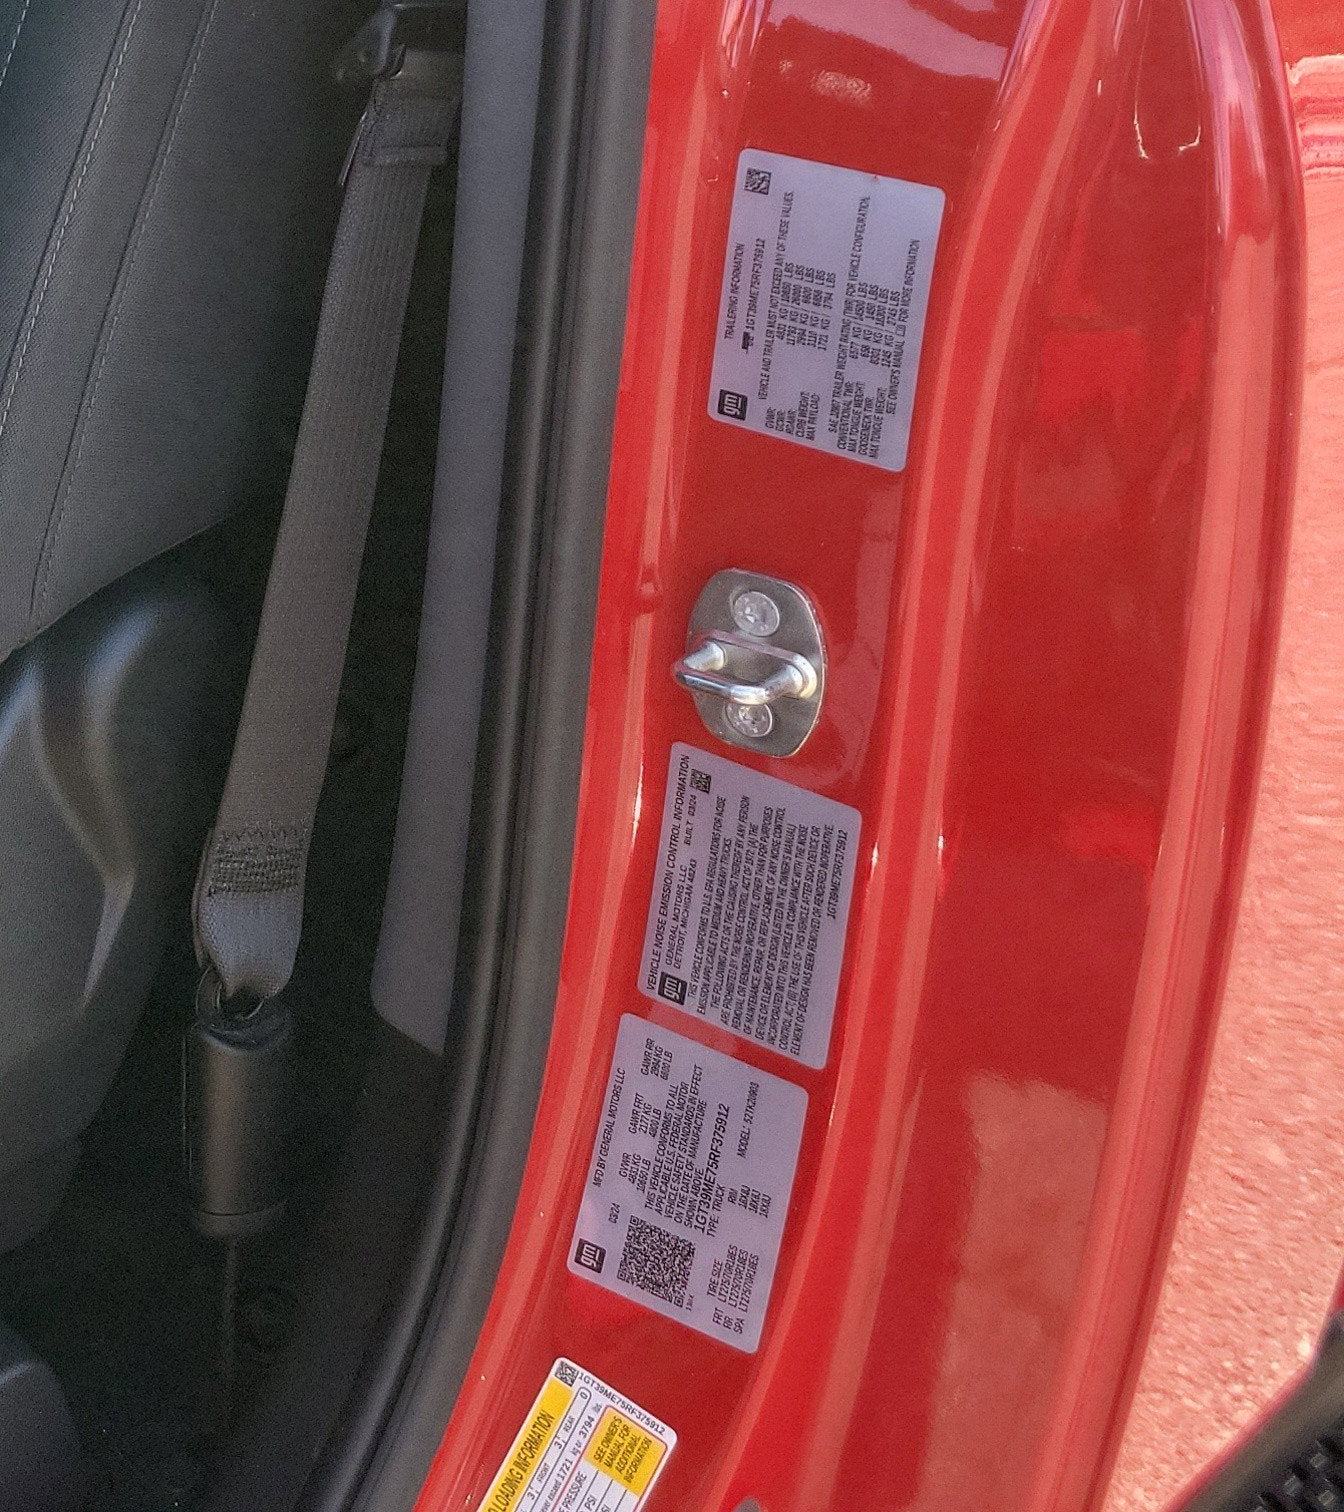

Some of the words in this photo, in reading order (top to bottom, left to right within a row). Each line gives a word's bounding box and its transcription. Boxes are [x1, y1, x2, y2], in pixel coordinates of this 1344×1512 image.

[729, 242, 745, 294] INFORMATION
[724, 295, 738, 340] TRAILERING
[672, 753, 690, 820] INFORMATION
[666, 821, 680, 869] CONTROL
[677, 863, 687, 882] LLC
[658, 868, 673, 916] EMISSION
[671, 883, 684, 922] MOTORS
[679, 882, 693, 928] MICHIGAN
[653, 916, 666, 948] NOISE
[665, 922, 678, 966] GENERAL
[673, 927, 686, 970] DETROIT,
[646, 948, 661, 992] VEHICLE
[644, 1037, 655, 1051] RR
[653, 1044, 664, 1059] KG
[663, 1049, 673, 1063] LB
[614, 1066, 626, 1084] LLC
[639, 1049, 652, 1076] GAWR
[667, 1082, 679, 1099] ALL
[689, 1063, 703, 1095] EFFECT
[607, 1083, 622, 1119] MOTORS
[633, 1092, 644, 1109] FRT
[641, 1101, 652, 1116] KG
[665, 1098, 675, 1111] TO
[675, 1080, 690, 1112] MOTOR
[687, 1094, 697, 1105] IN
[627, 1108, 640, 1134] GAWR
[638, 1114, 649, 1134] 2177
[651, 1106, 661, 1120] LB
[599, 1118, 615, 1157] GENERAL
[655, 1110, 673, 1157] CONFORMS
[668, 1110, 683, 1148] FEDERAL
[677, 1103, 695, 1153] STANDARDS
[687, 1098, 707, 1159] MANUFACTURE
[596, 1155, 607, 1169] BY
[618, 1151, 631, 1178] GVWR
[631, 1152, 641, 1167] KG
[640, 1157, 651, 1170] LB
[648, 1155, 663, 1191] VEHICLE
[671, 1152, 685, 1185] SAFETY
[684, 1158, 695, 1171] OF
[693, 1102, 730, 1233] 1GT39ME75RF375912
[592, 1168, 604, 1187] MFD
[654, 1163, 672, 1215] APPLICABLE
[679, 1170, 692, 1193] DATE
[644, 1190, 656, 1210] THIS
[663, 1183, 679, 1219] VEHICLE
[676, 1192, 688, 1210] THE
[711, 1183, 725, 1212] TRUCK
[727, 1187, 738, 1204] RIM
[673, 1209, 684, 1224] ON
[683, 1196, 698, 1228] SHOWN
[706, 1212, 719, 1238] TYPE:
[710, 1258, 723, 1278] SIZE
[706, 1276, 719, 1297] TIRE
[712, 1306, 724, 1325] FRT
[722, 1315, 733, 1330] RR
[733, 1316, 744, 1334] SPA
[578, 1372, 666, 1436] 1GT39ME75RF375912
[579, 1390, 588, 1400] 0
[553, 1440, 562, 1449] 3
[556, 1457, 573, 1480] 1721
[578, 1414, 595, 1439] 3794
[593, 1445, 607, 1462] SEE
[603, 1438, 623, 1468] MANUAL
[617, 1422, 631, 1440] FOR
[614, 1431, 641, 1474] ADDITIONAL
[491, 1466, 524, 1512] LOADING
[511, 1407, 554, 1473] INFORMATION
[623, 1435, 652, 1484] INFORMATION
[526, 1491, 535, 1500] 3
[561, 1470, 587, 1511] PRESSURE
[583, 1494, 597, 1511] PSI
